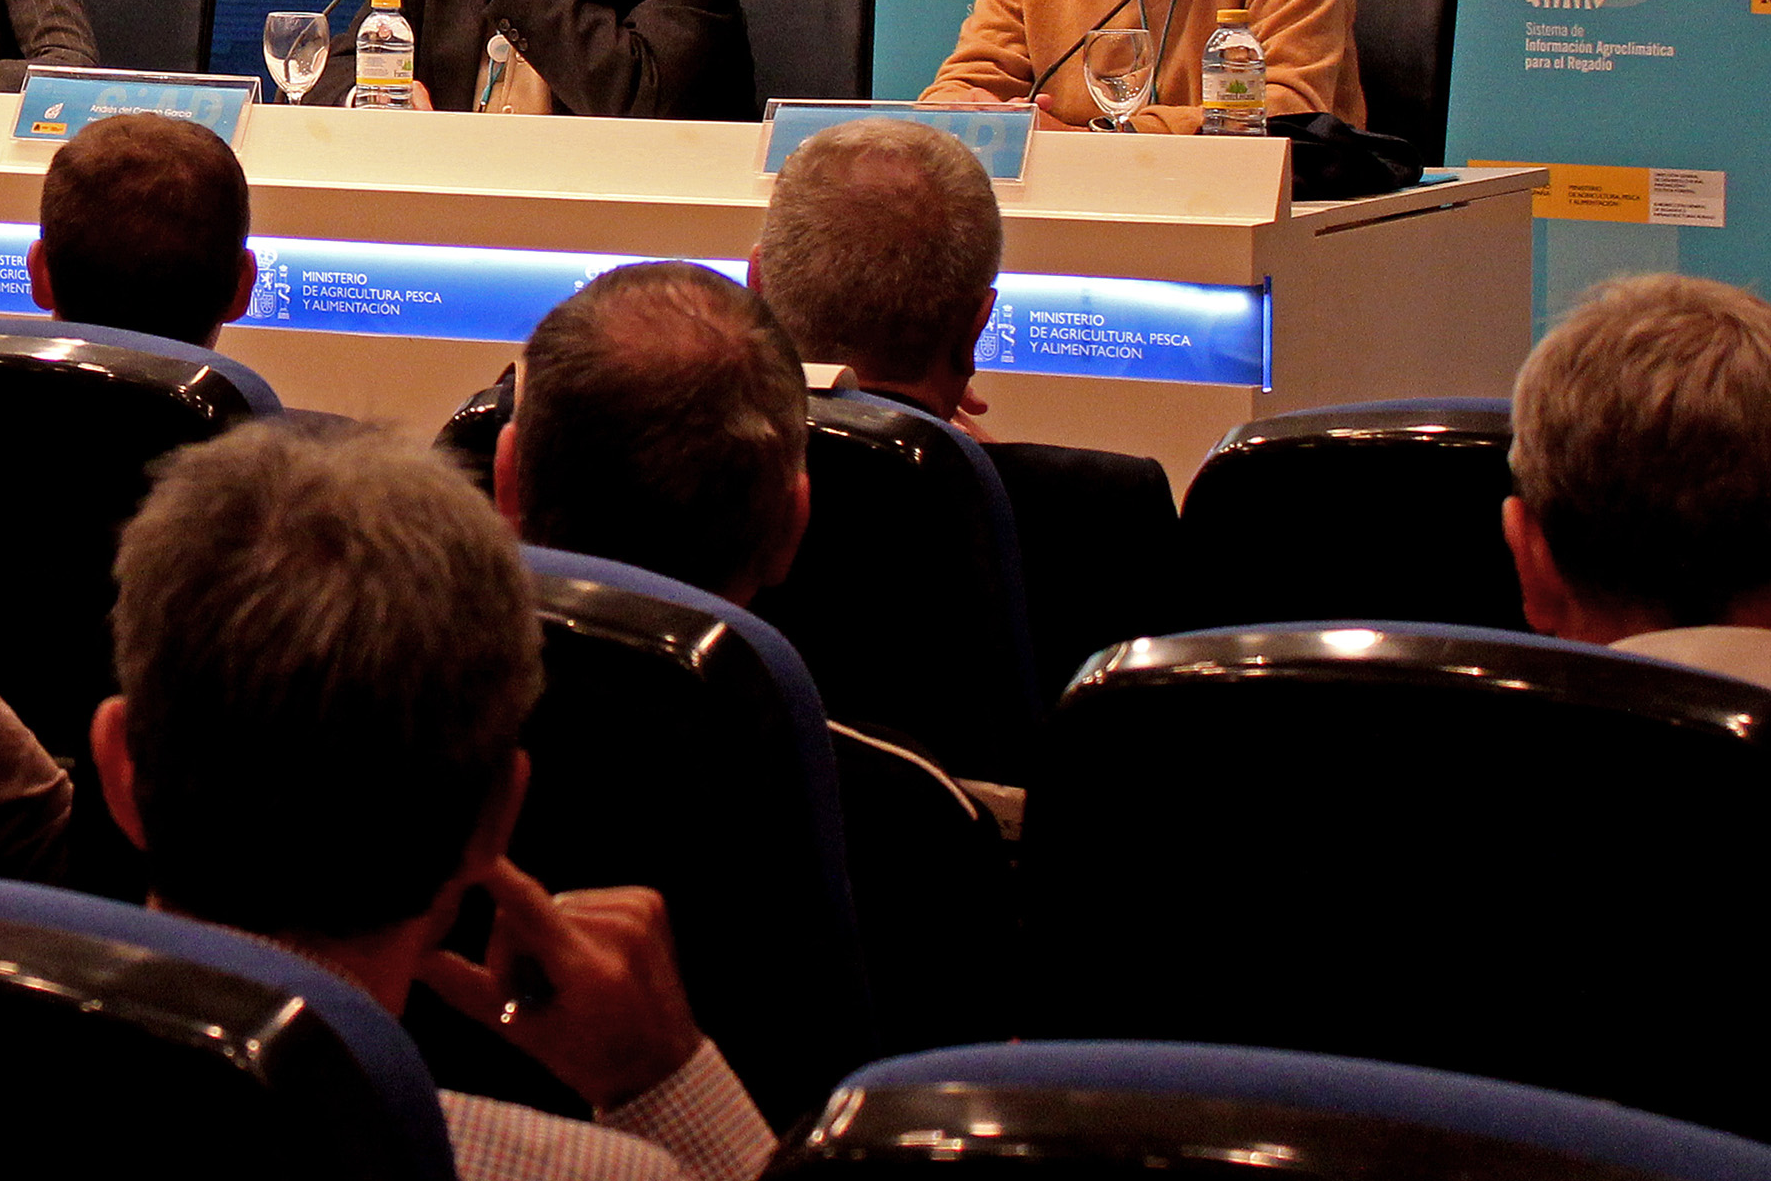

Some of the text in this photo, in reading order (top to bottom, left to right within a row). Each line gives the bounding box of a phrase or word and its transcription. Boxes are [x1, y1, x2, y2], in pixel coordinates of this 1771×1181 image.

[1526, 22, 1584, 37] Sistema de
[1525, 38, 1675, 57] Información Agroclimática
[1525, 57, 1550, 70] para
[1554, 57, 1564, 69] el
[302, 270, 368, 285] MINISTERIO
[303, 285, 442, 304] DE AGRICULTURA, PESCA
[303, 299, 400, 315] Y ALIMENTACIÓN
[1029, 310, 1105, 327] MINISTERIO
[1030, 326, 1191, 347] DE AGRICULTURA, PESCA
[1029, 340, 1143, 359] Y ALIMENTACIÓN
